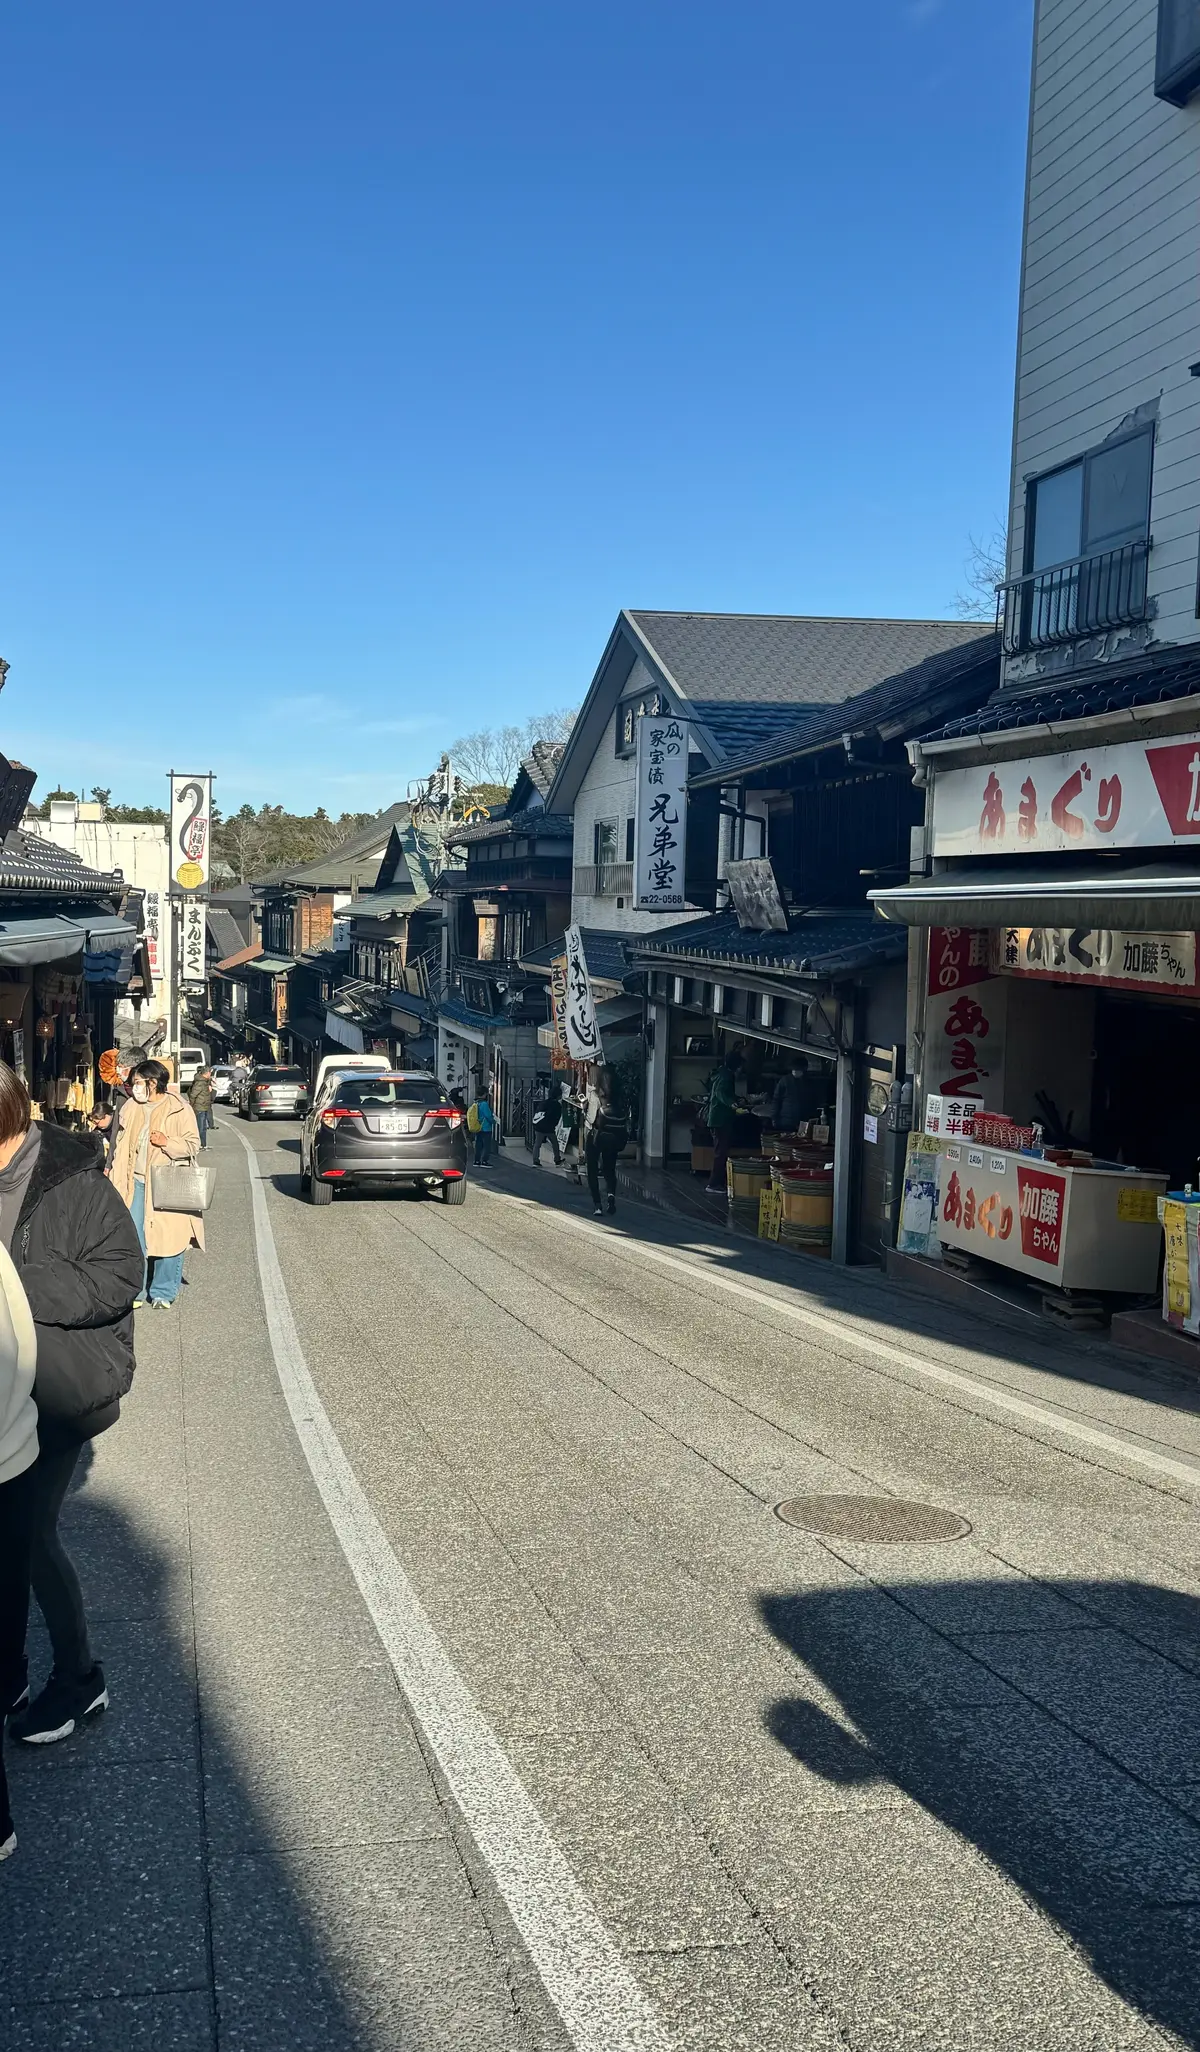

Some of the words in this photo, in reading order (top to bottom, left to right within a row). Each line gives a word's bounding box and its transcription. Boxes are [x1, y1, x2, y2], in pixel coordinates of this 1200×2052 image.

[648, 729, 666, 784] 家宝漬
[664, 721, 683, 755] 瓜の
[980, 762, 1122, 840] あまぐり
[648, 793, 679, 890] 兄弟堂
[649, 895, 682, 904] 22-0568
[948, 1102, 976, 1117] 全品
[943, 1170, 1013, 1241] あまぐり
[1020, 1182, 1060, 1225] 加藤
[1033, 1226, 1059, 1253] ちゃん
